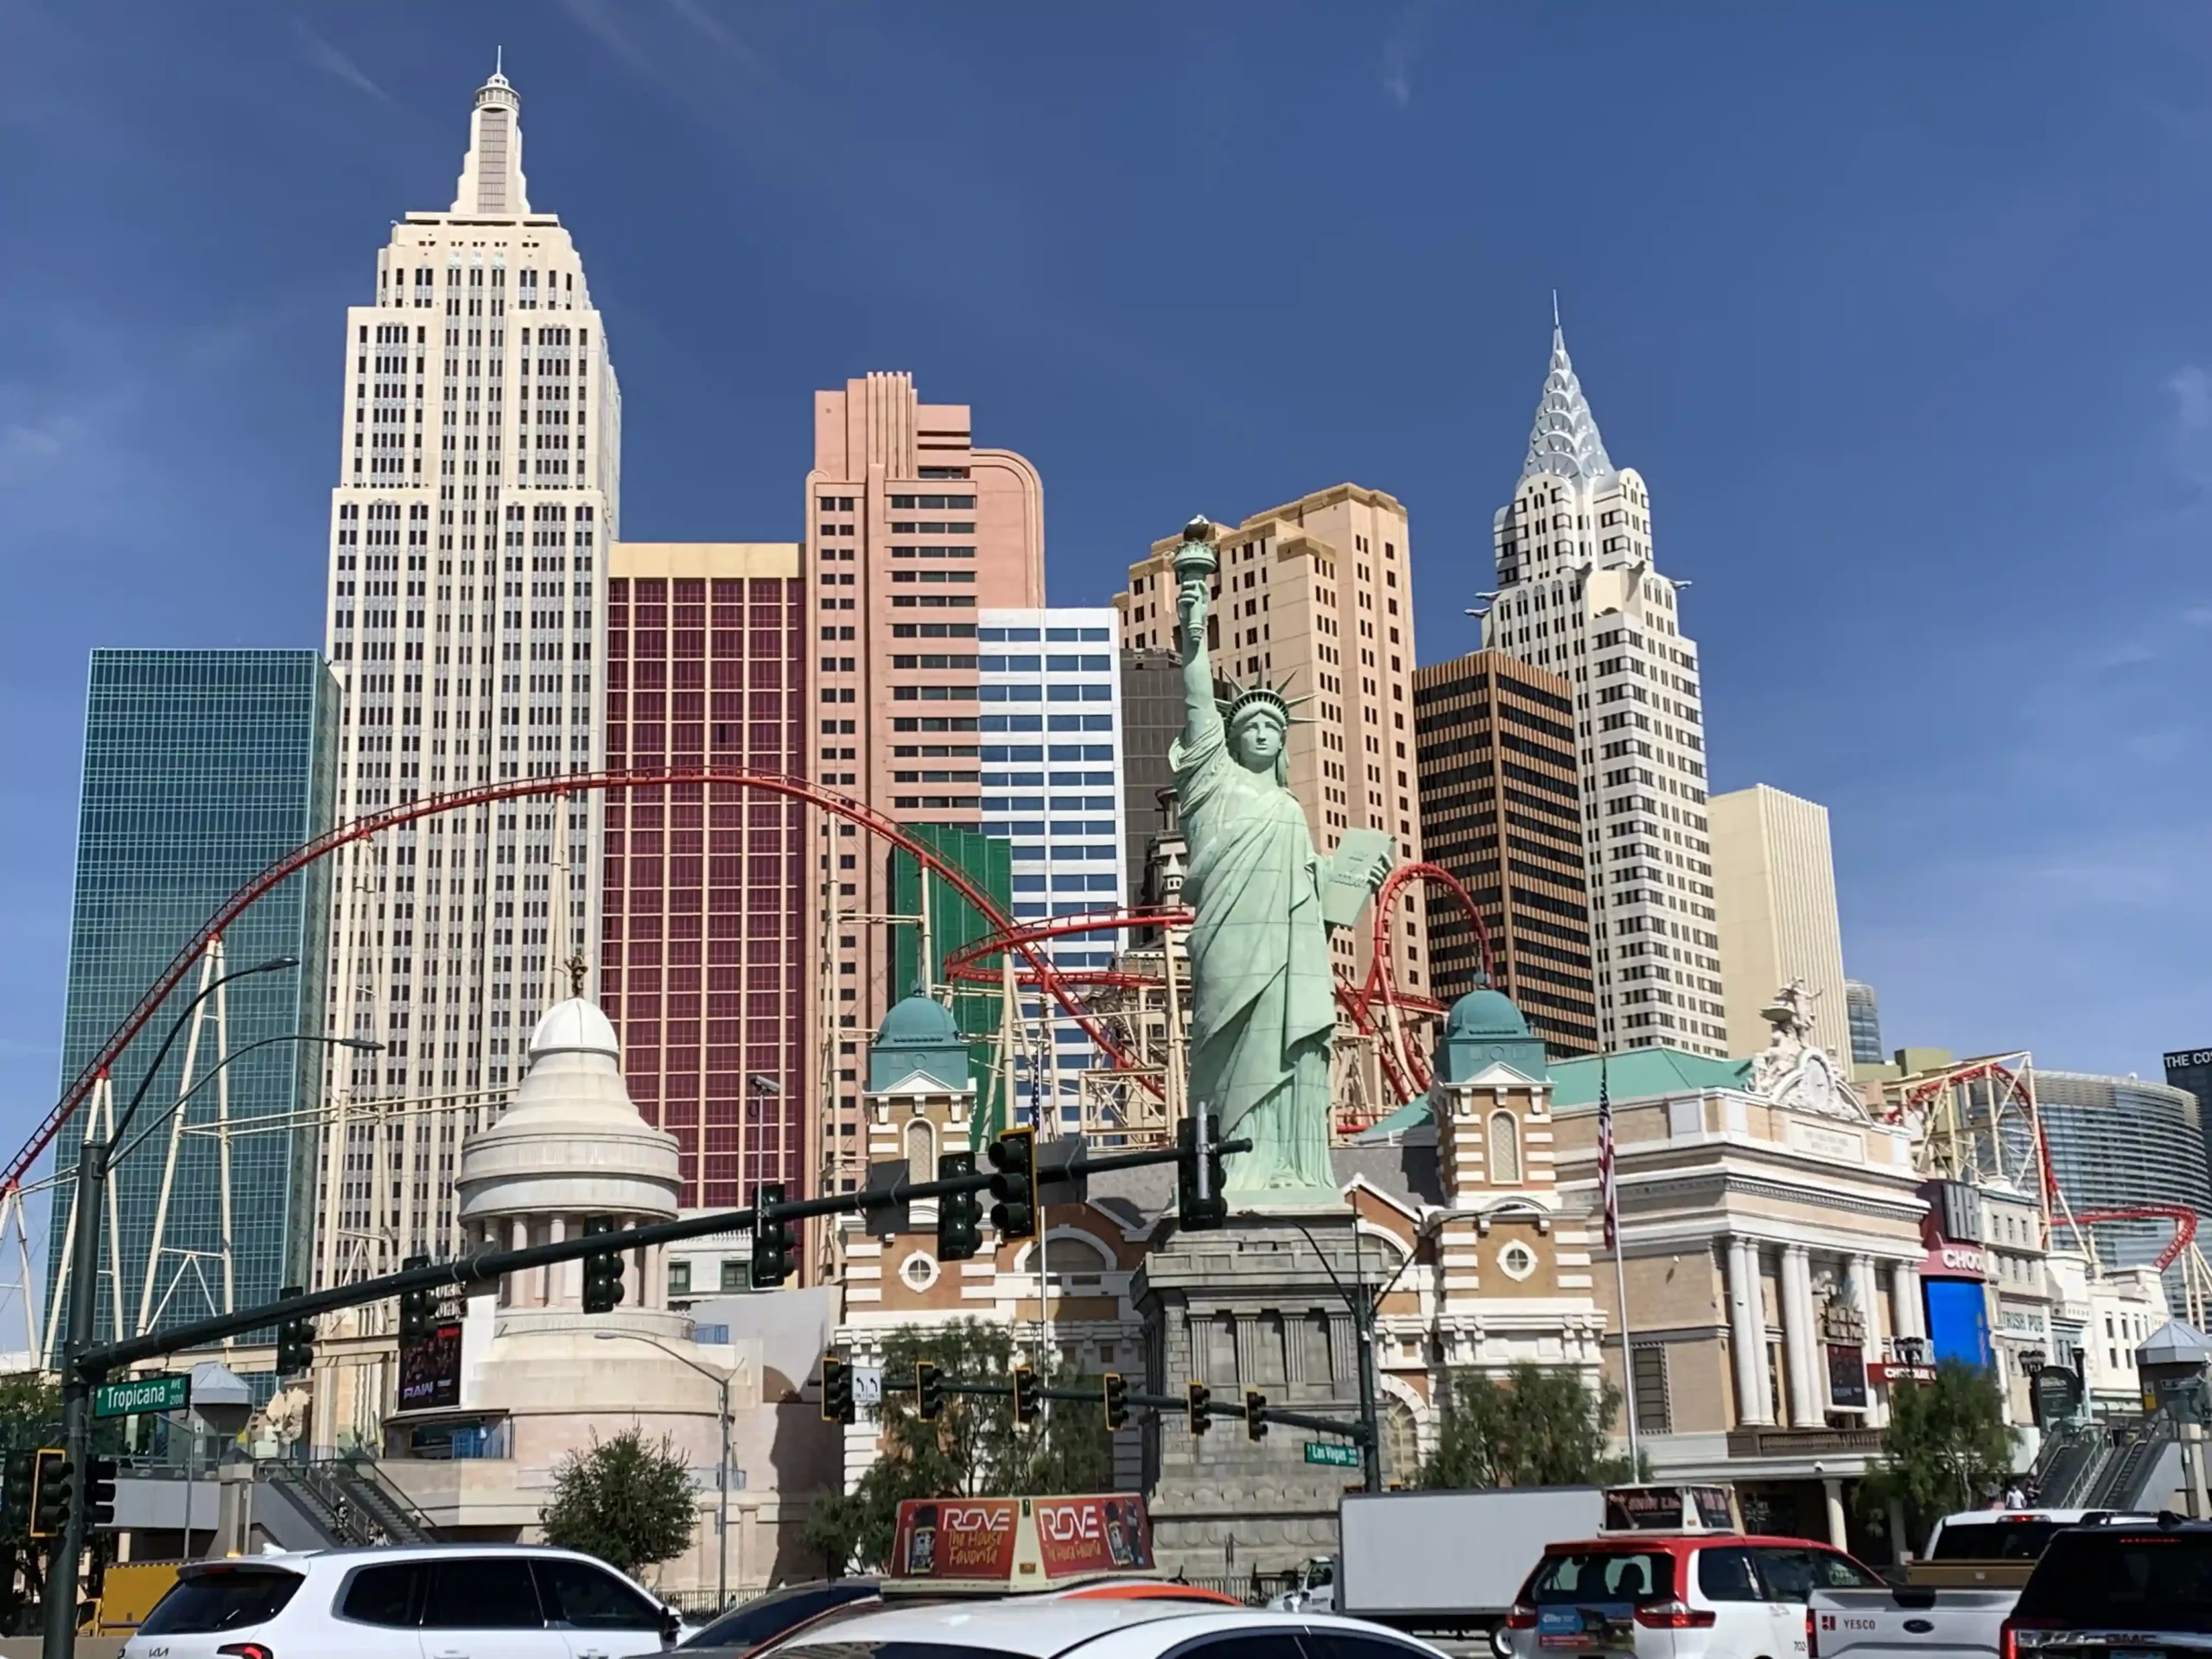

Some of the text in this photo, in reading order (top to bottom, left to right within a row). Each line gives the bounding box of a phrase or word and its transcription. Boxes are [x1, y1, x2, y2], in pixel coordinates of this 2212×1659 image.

[2164, 1051, 2212, 1068] THE CO
[2027, 1314, 2044, 1332] PUB
[107, 1384, 165, 1412] Tropicana
[170, 1378, 181, 1389] AVE
[404, 1382, 434, 1400] RAW
[1313, 1444, 1325, 1459] Las
[1325, 1446, 1346, 1464] Vegas
[943, 1509, 1011, 1531] ROVE
[1039, 1506, 1099, 1541] ROVE
[1843, 1619, 1876, 1630] YESCO
